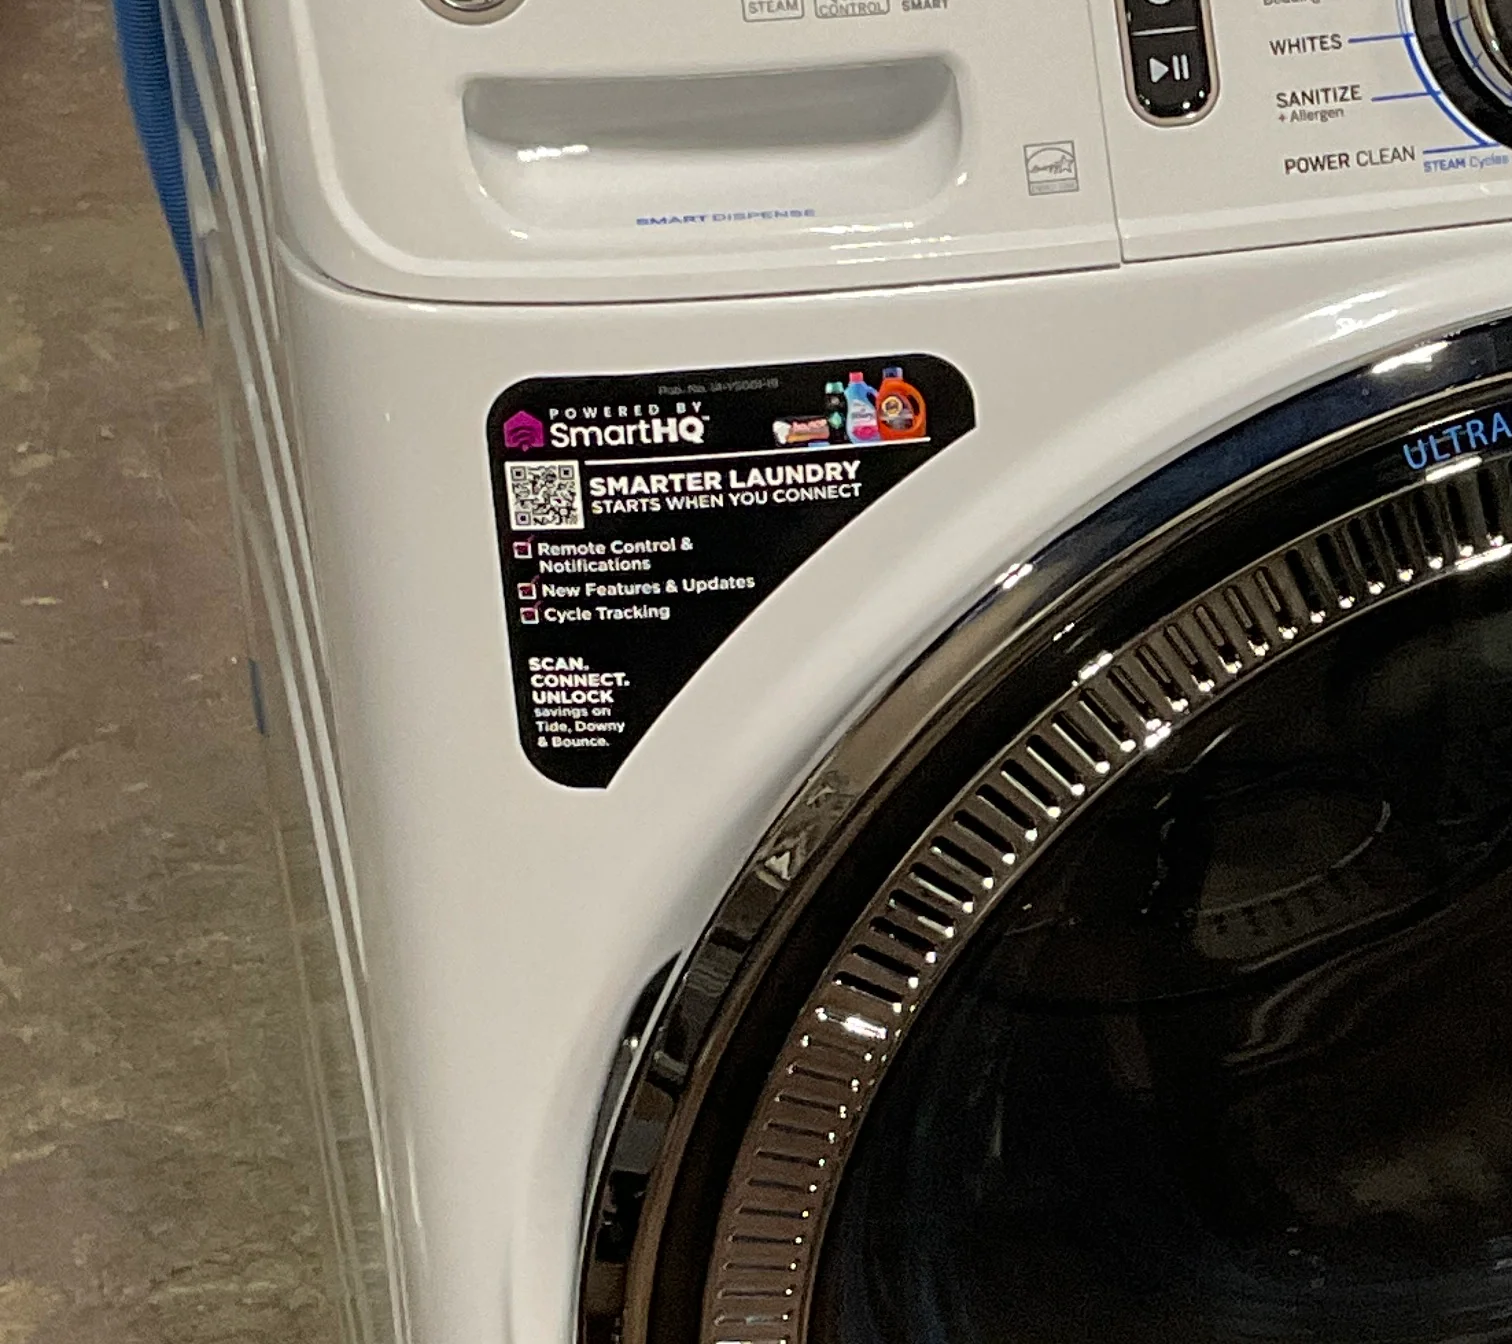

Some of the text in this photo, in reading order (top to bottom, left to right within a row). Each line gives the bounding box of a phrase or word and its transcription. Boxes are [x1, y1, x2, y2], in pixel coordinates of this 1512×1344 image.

[747, 0, 799, 15] STEAM
[818, 1, 884, 18] CONTROL
[1269, 33, 1343, 56] WHITES
[1276, 84, 1363, 109] SANITIZE
[1278, 106, 1345, 124] + Allergen
[1284, 145, 1416, 175] POWER CLEAN
[1423, 152, 1510, 173] STEAM Cycles
[636, 208, 816, 226] SMART DISPENSE
[549, 401, 702, 421] POWERED BY
[550, 415, 705, 449] SmartHQ
[589, 459, 862, 498] SMARTER LAUNDRY
[591, 482, 863, 515] STARTS WHEN YOU CONNECT
[537, 536, 694, 557] Remote Control &
[539, 557, 652, 574] Notifications
[541, 574, 756, 598] New Features & Updates
[543, 604, 672, 624] Cycle Tracking
[528, 656, 590, 672] SCAN.
[530, 672, 631, 688] CONNECT.
[531, 689, 615, 705] UNLOCK
[533, 705, 612, 720] savings on
[535, 720, 626, 735] Tide, Downy
[537, 735, 611, 748] & Bounce.
